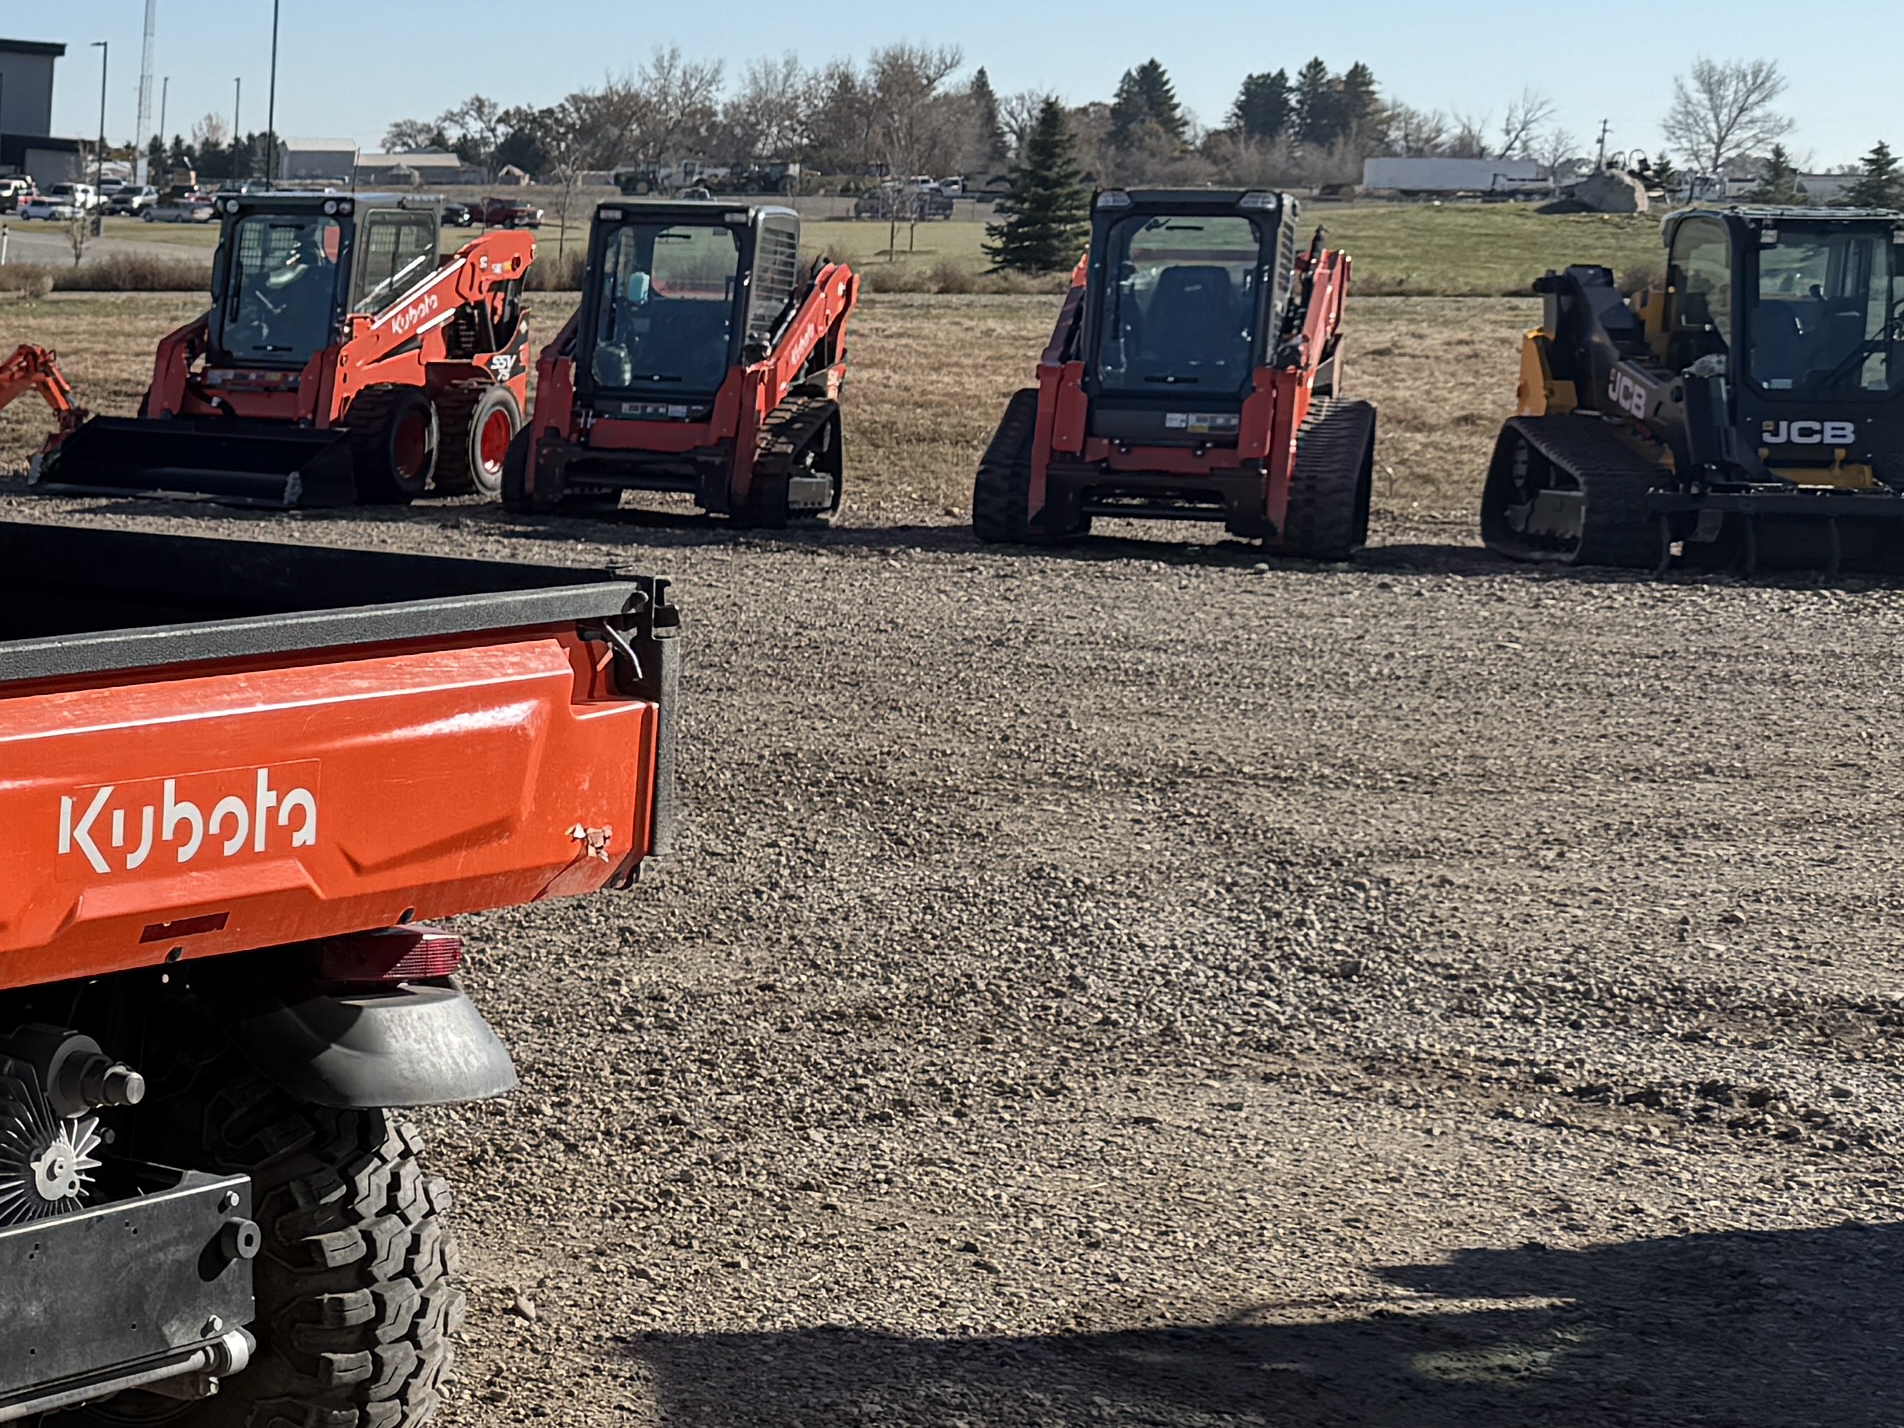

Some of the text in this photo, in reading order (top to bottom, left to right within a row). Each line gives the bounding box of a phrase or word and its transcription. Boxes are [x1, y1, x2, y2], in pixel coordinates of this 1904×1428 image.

[391, 293, 439, 335] Kubota
[1608, 369, 1648, 420] JCB
[1762, 421, 1855, 444] JCB
[58, 767, 318, 874] Kubota
